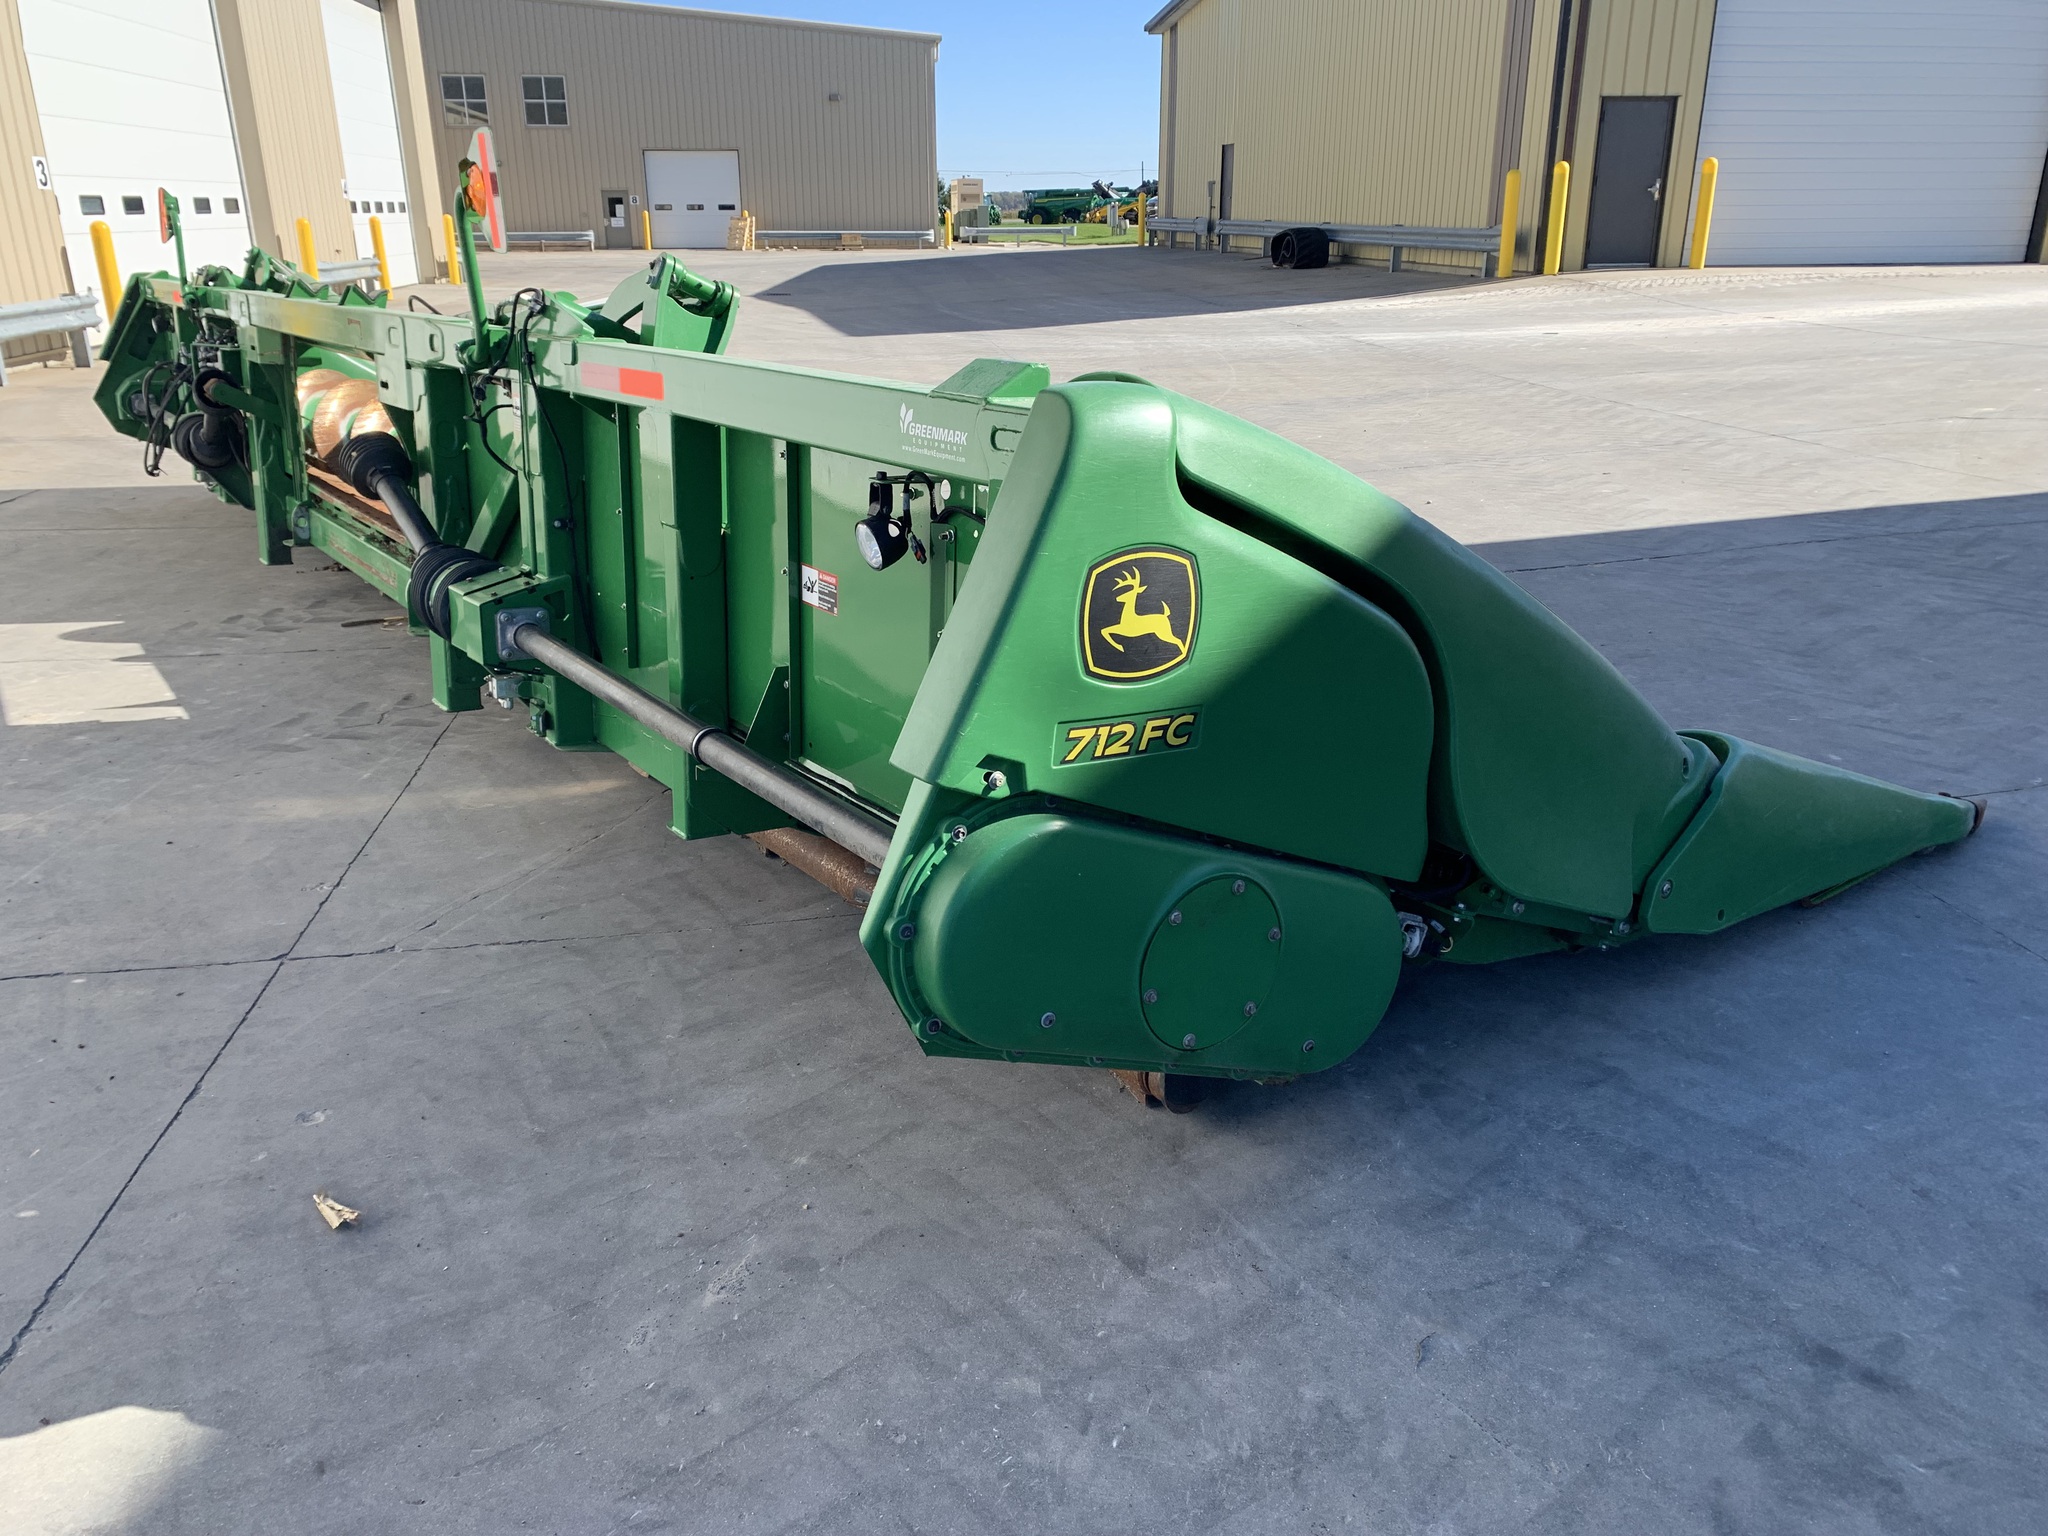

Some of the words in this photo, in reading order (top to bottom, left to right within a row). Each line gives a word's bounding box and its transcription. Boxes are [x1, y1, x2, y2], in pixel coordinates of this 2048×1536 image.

[36, 160, 48, 187] 3
[909, 422, 968, 446] GREENMARK
[912, 437, 963, 453] EQUIPMENT
[902, 444, 966, 463] www.GreenMarkEquipment.com
[1062, 721, 1136, 763] 712
[1137, 712, 1197, 753] FC
